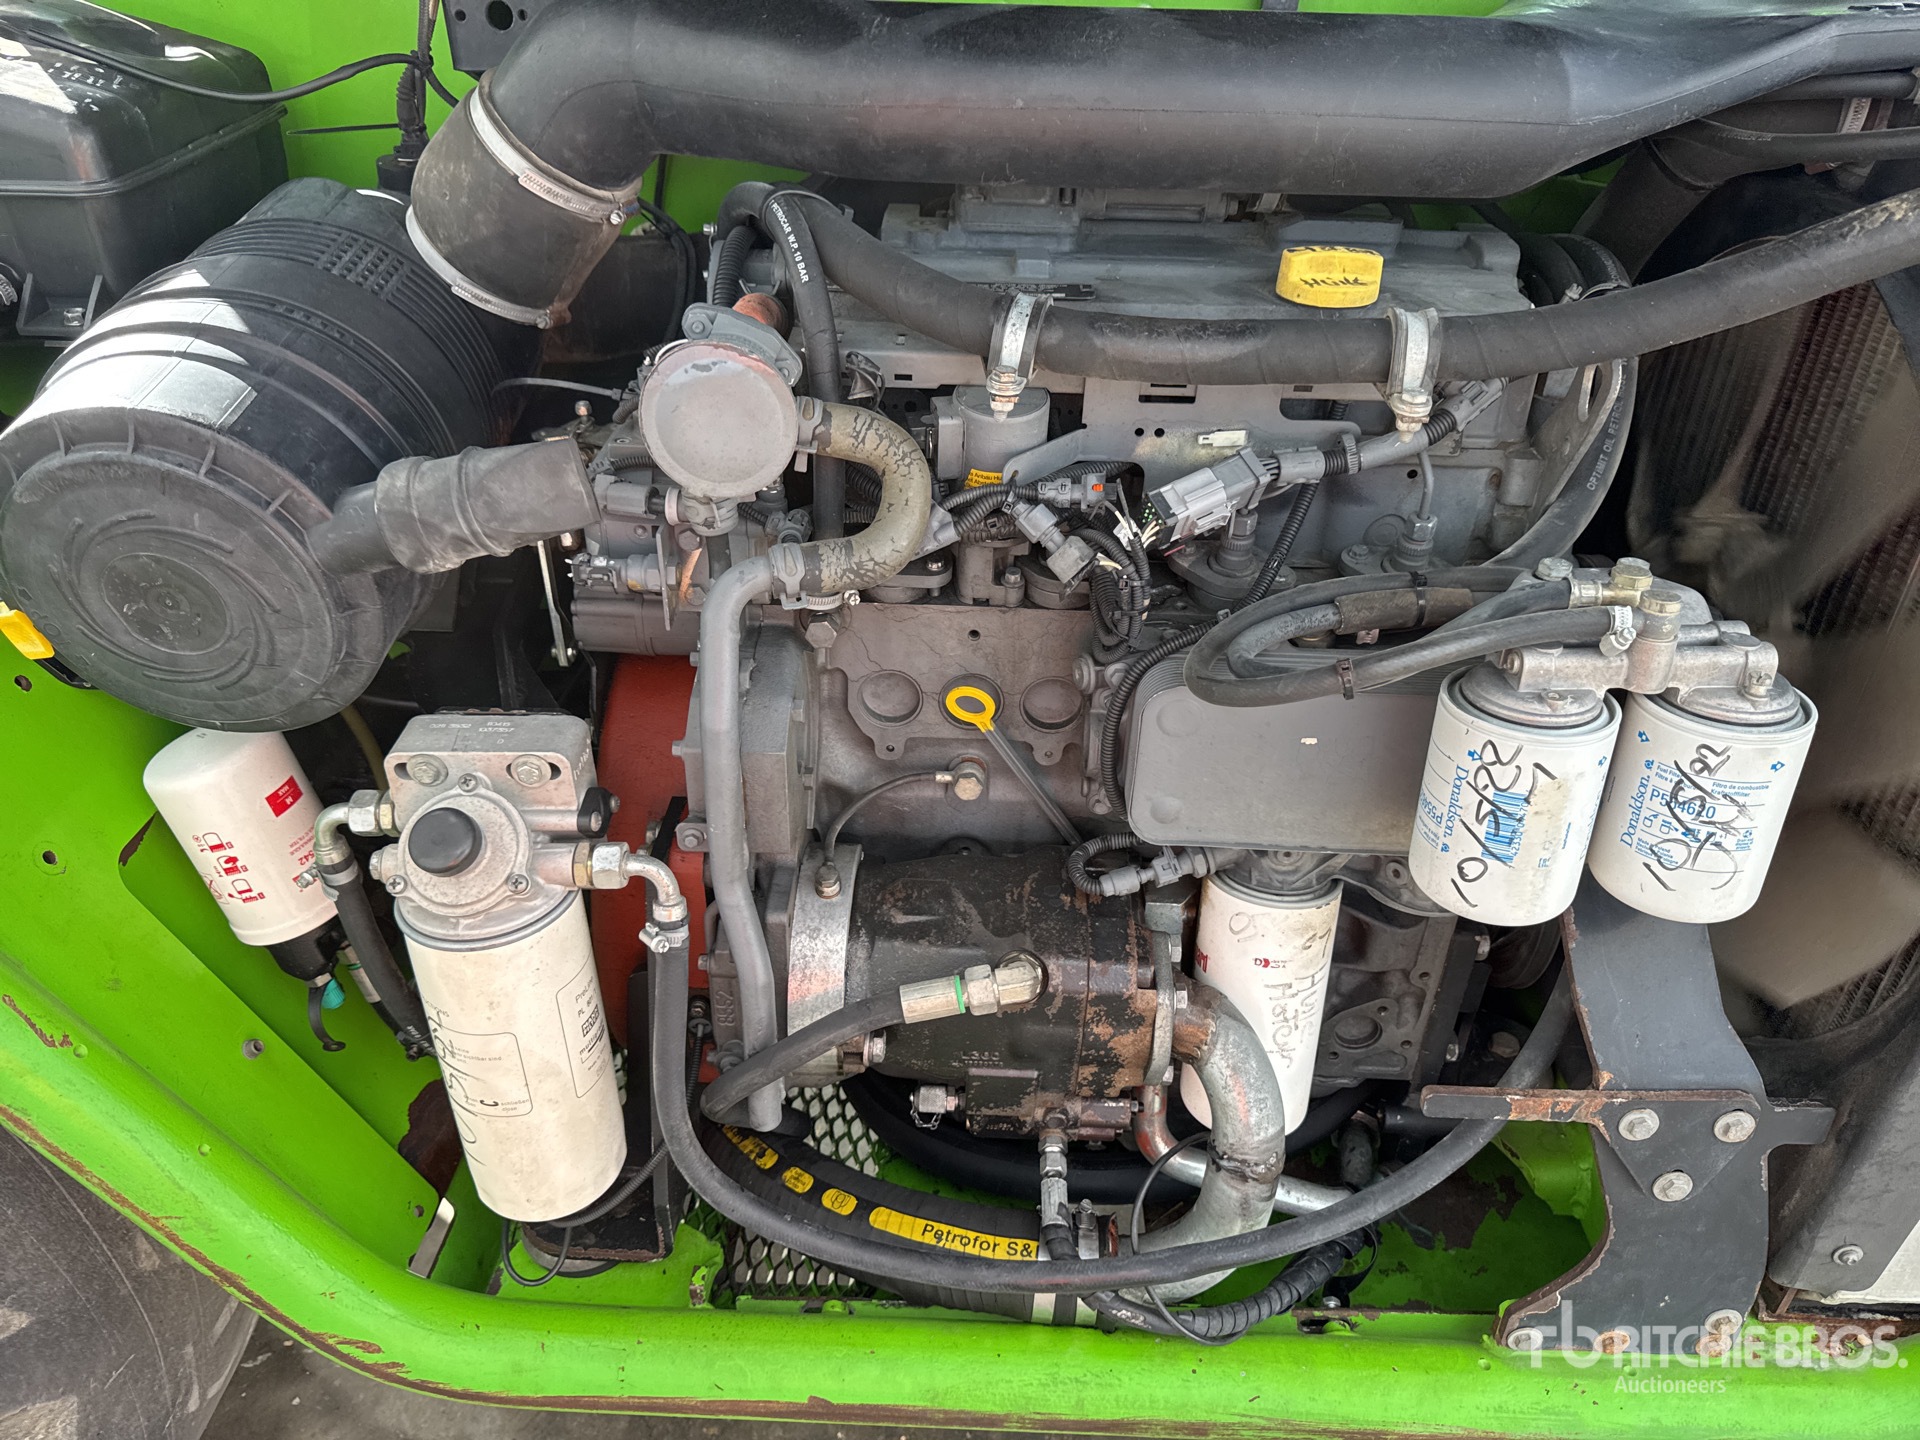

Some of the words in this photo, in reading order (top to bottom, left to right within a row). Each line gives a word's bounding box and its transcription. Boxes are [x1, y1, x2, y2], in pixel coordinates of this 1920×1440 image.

[770, 203, 792, 234] PETROCAR
[793, 251, 803, 262] 10
[796, 262, 809, 283] BAR
[1602, 438, 1616, 453] OIL
[1712, 781, 1727, 790] Filtro
[1443, 763, 1470, 839] Donaldson.
[1619, 774, 1652, 849] Donaldson.
[298, 849, 316, 866] 542
[921, 1223, 1001, 1254] Petrofor
[1006, 1240, 1039, 1259] S&
